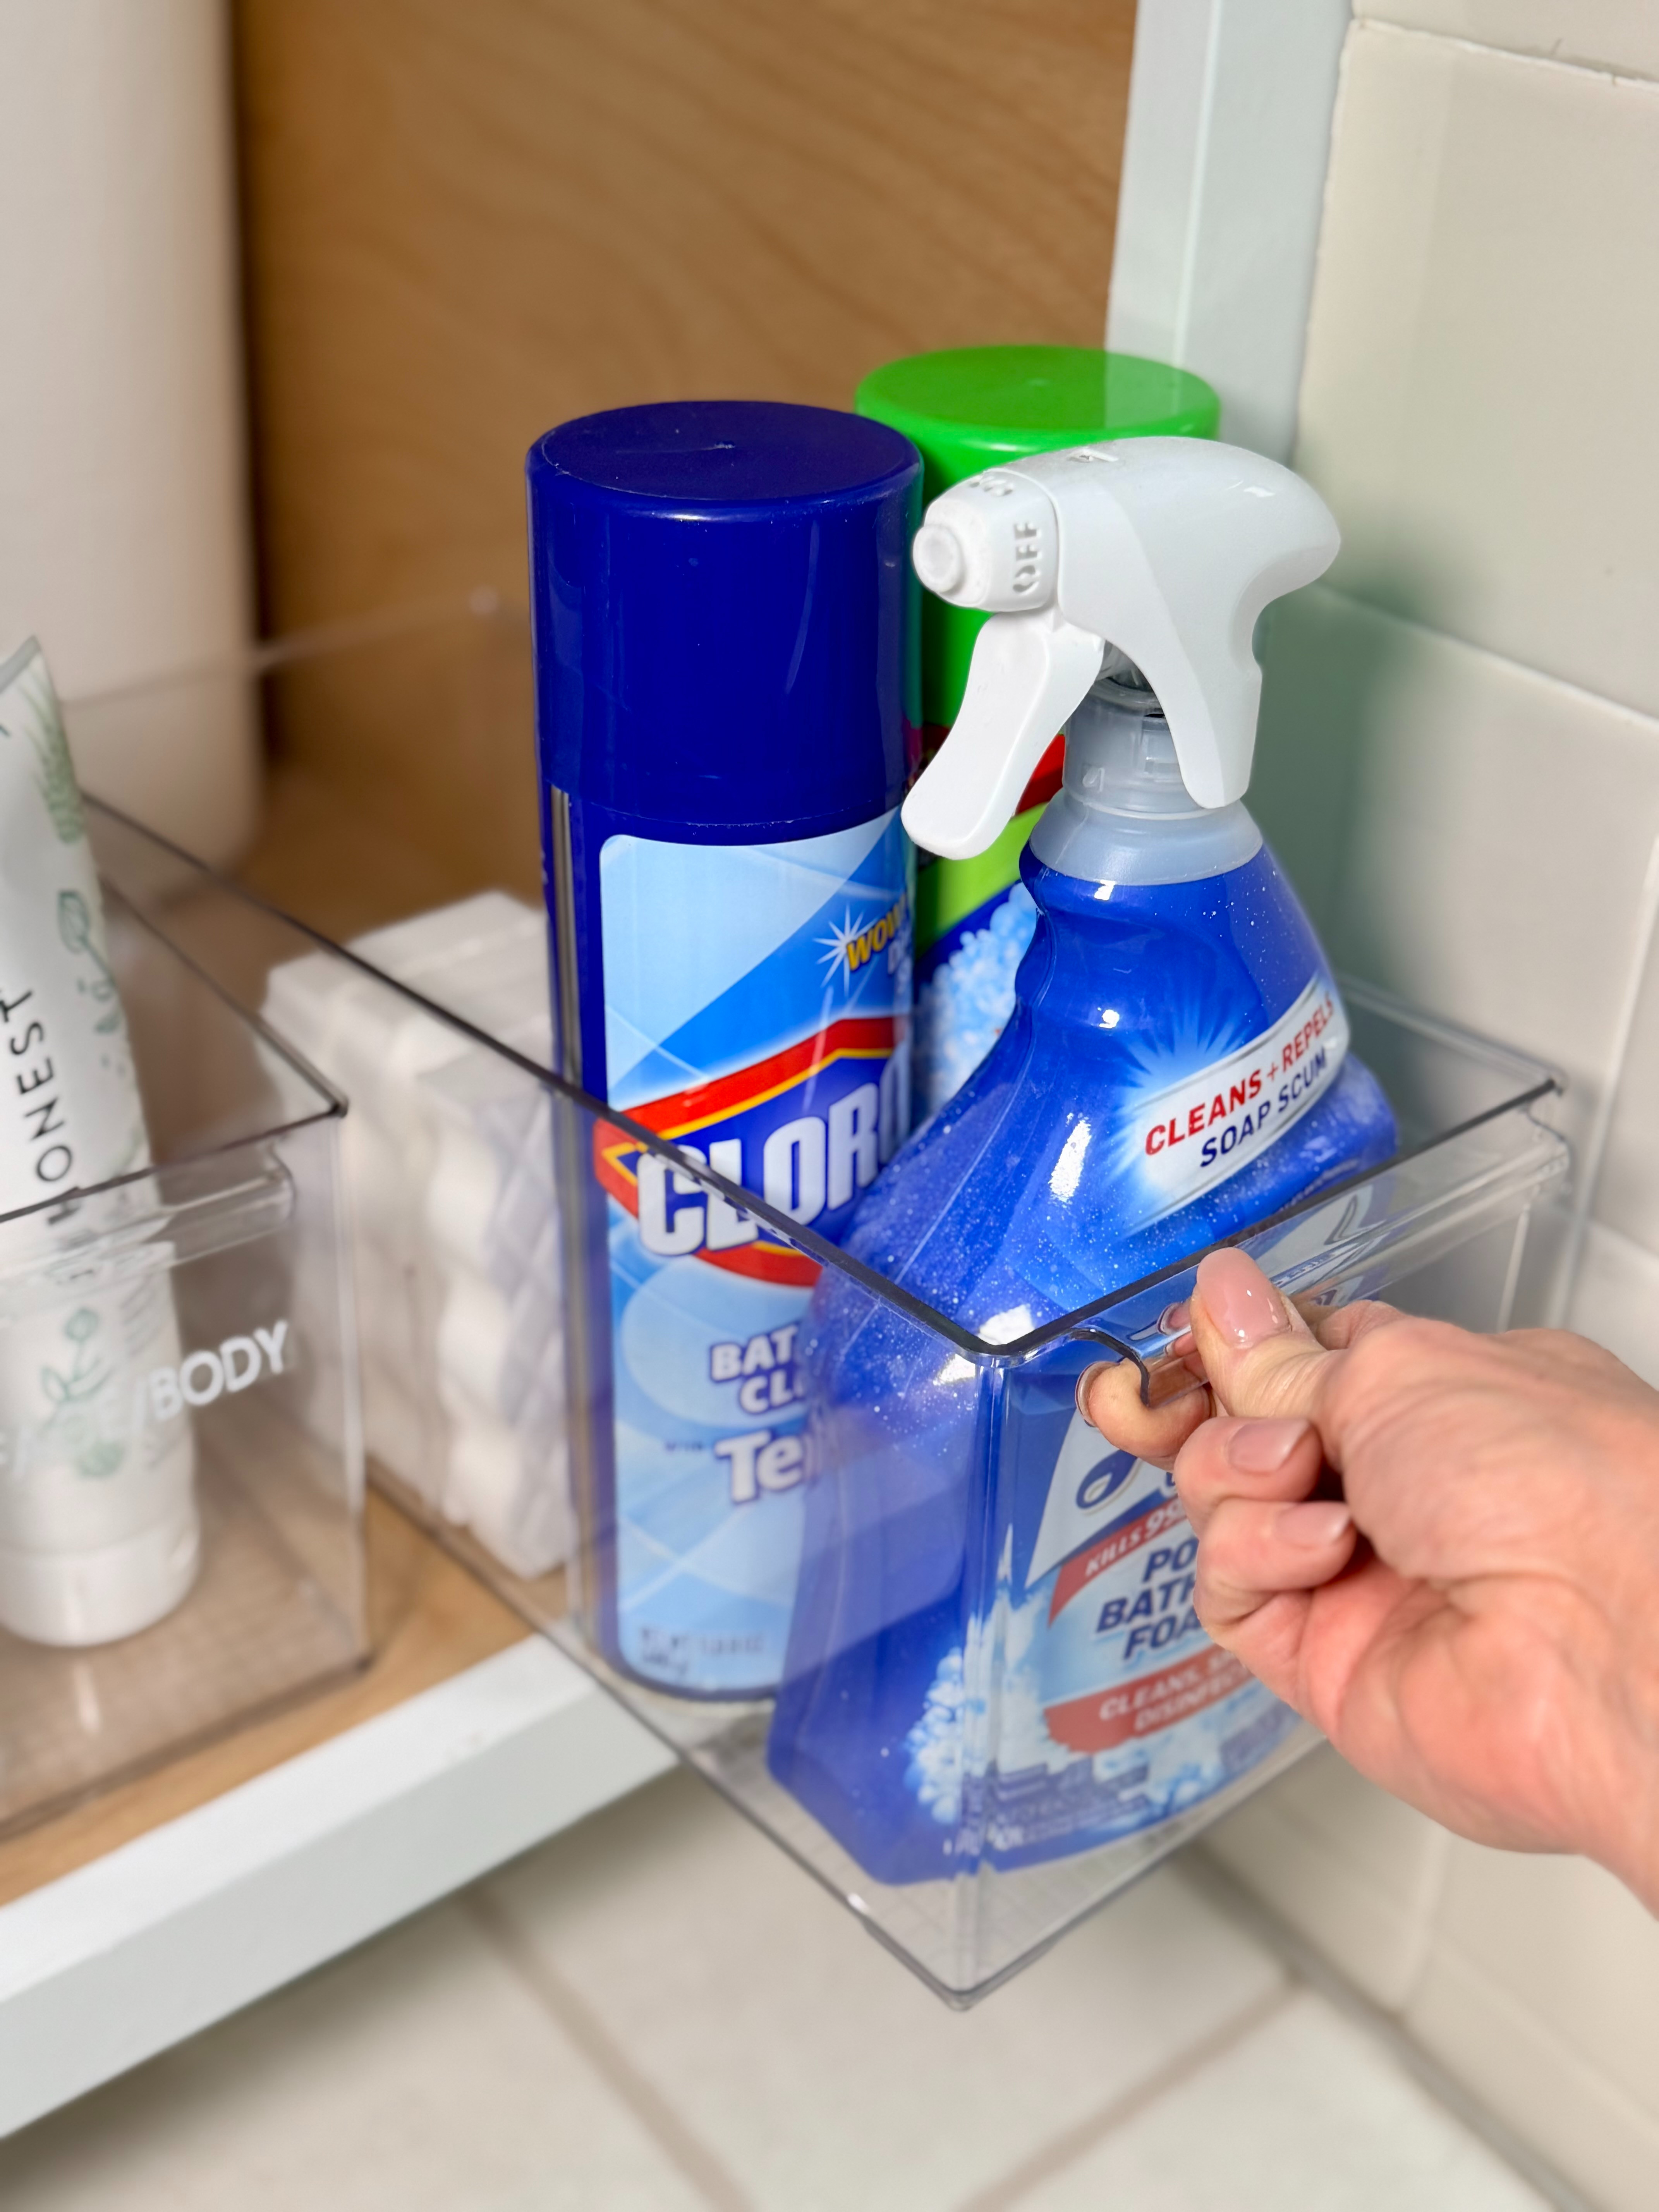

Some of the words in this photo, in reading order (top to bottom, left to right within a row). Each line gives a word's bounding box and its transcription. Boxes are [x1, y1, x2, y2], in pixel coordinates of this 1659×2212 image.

[1012, 521, 1042, 594] OFF
[1145, 1069, 1262, 1156] CLEANS
[1282, 991, 1333, 1073] REPELS
[1200, 1100, 1271, 1168] SOAP
[1085, 1527, 1143, 1576] KILLS
